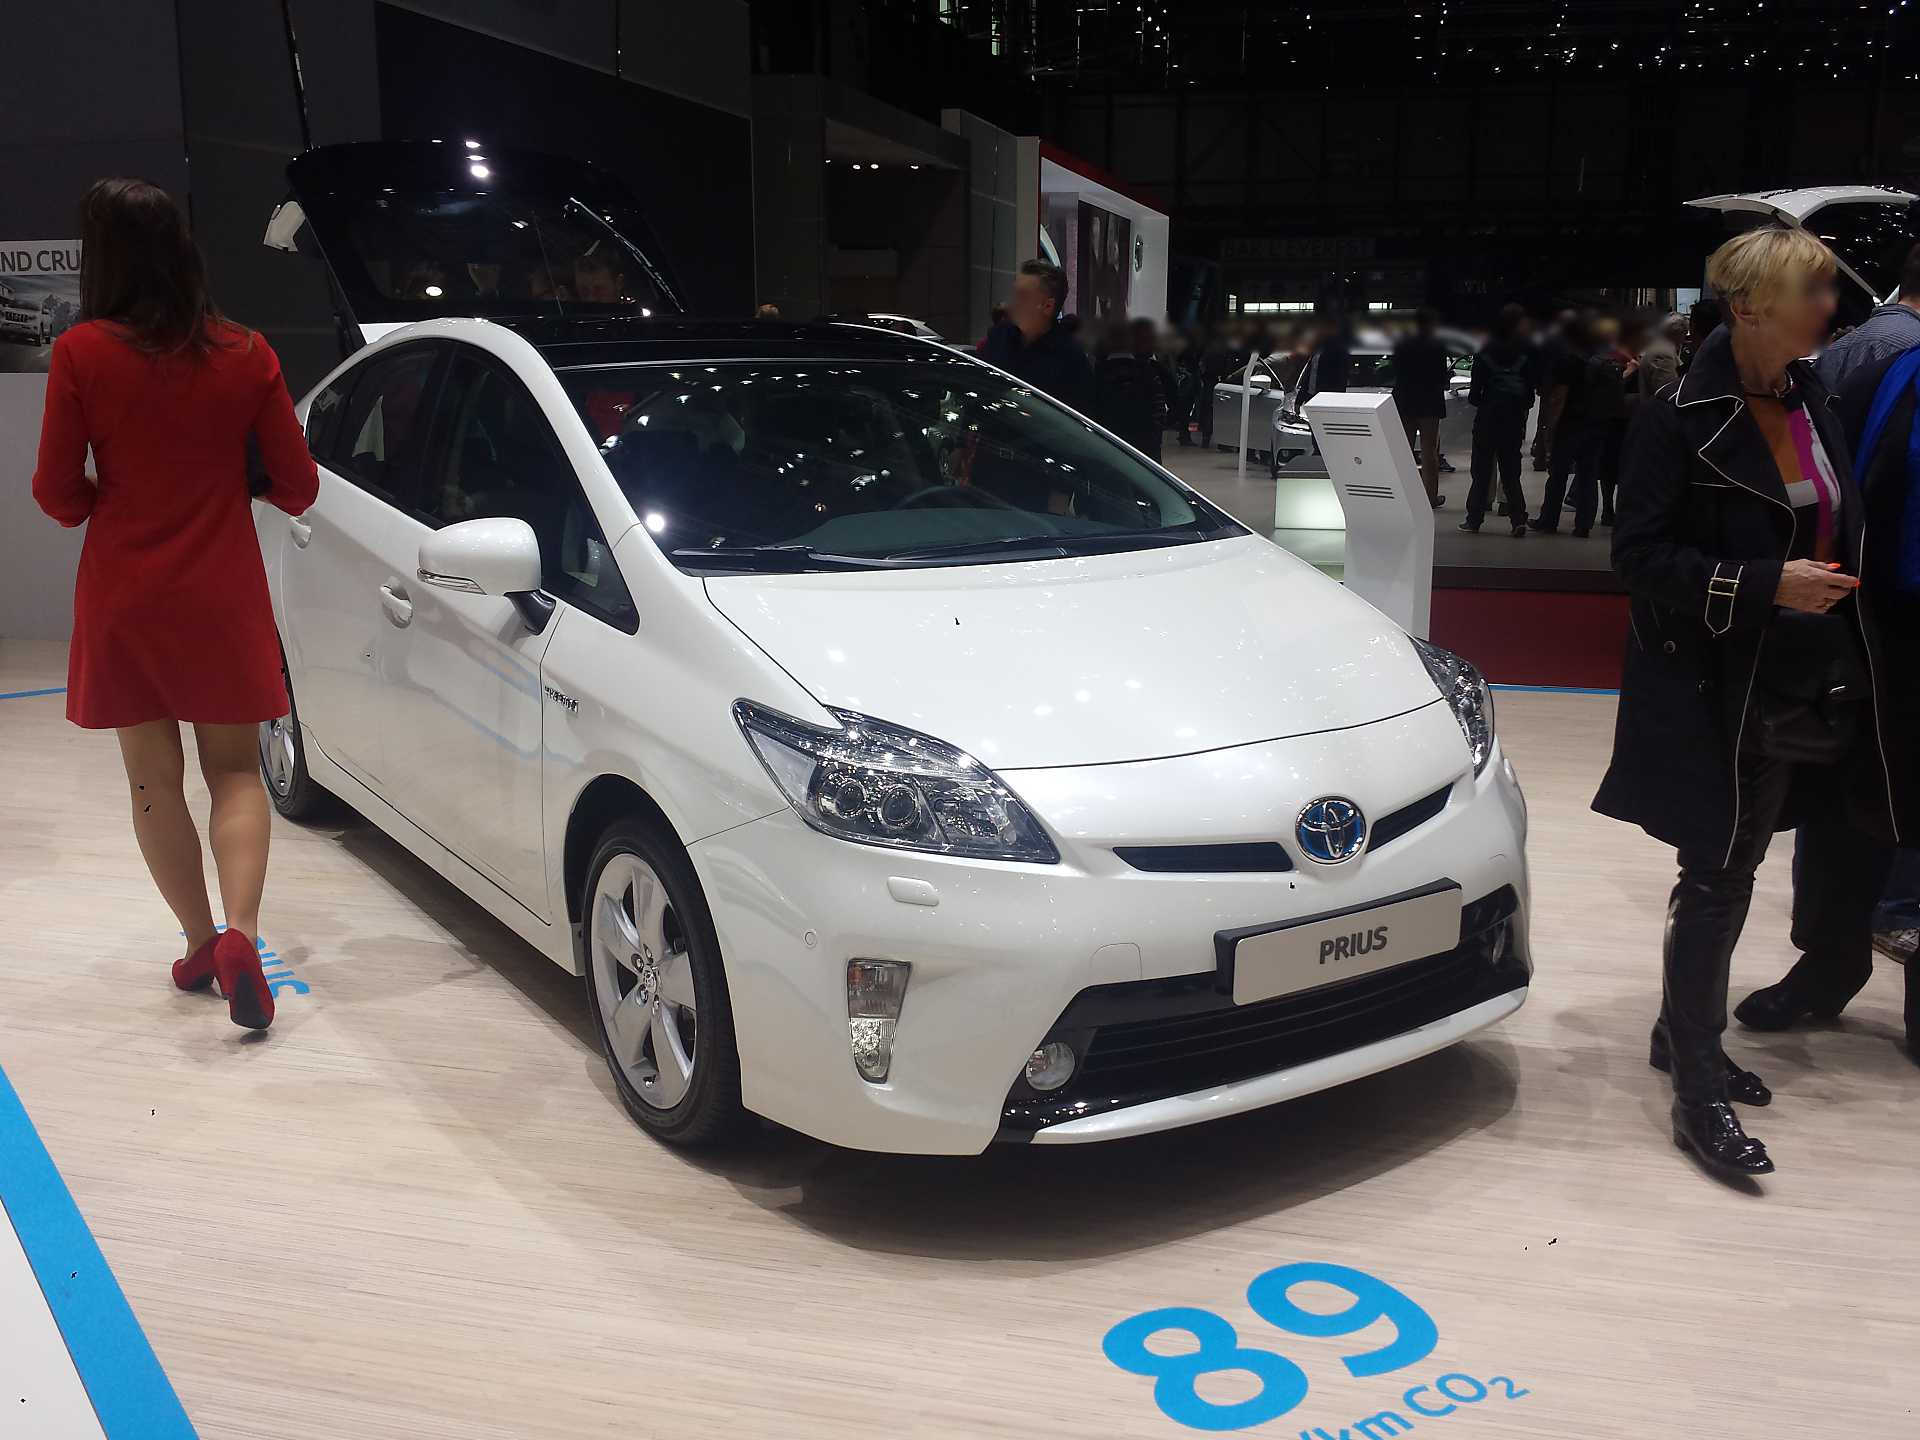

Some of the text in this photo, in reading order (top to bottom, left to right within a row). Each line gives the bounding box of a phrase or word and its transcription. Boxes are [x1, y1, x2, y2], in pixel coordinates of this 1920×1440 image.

[0, 250, 32, 272] ND
[1319, 926, 1388, 965] PRIUS
[1102, 1262, 1439, 1431] 89
